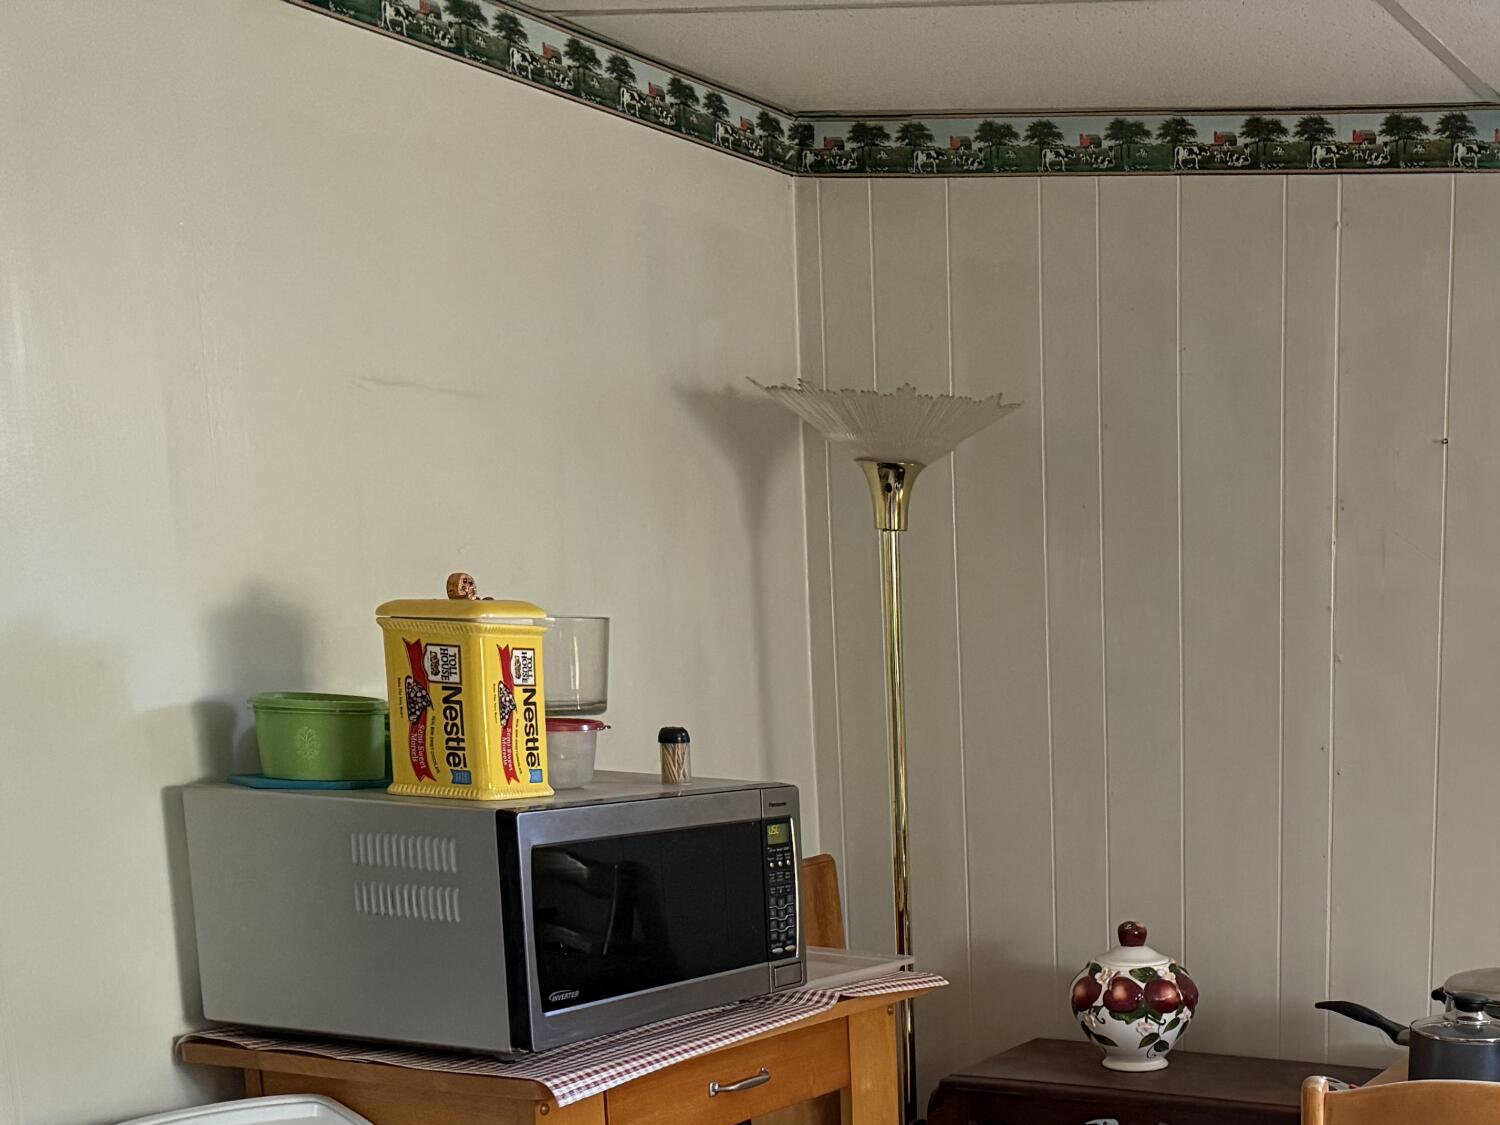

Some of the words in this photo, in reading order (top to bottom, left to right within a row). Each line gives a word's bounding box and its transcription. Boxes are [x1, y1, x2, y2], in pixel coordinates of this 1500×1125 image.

[440, 647, 450, 681] HOUSE
[448, 653, 458, 677] TOLL
[520, 651, 528, 684] HOUSE
